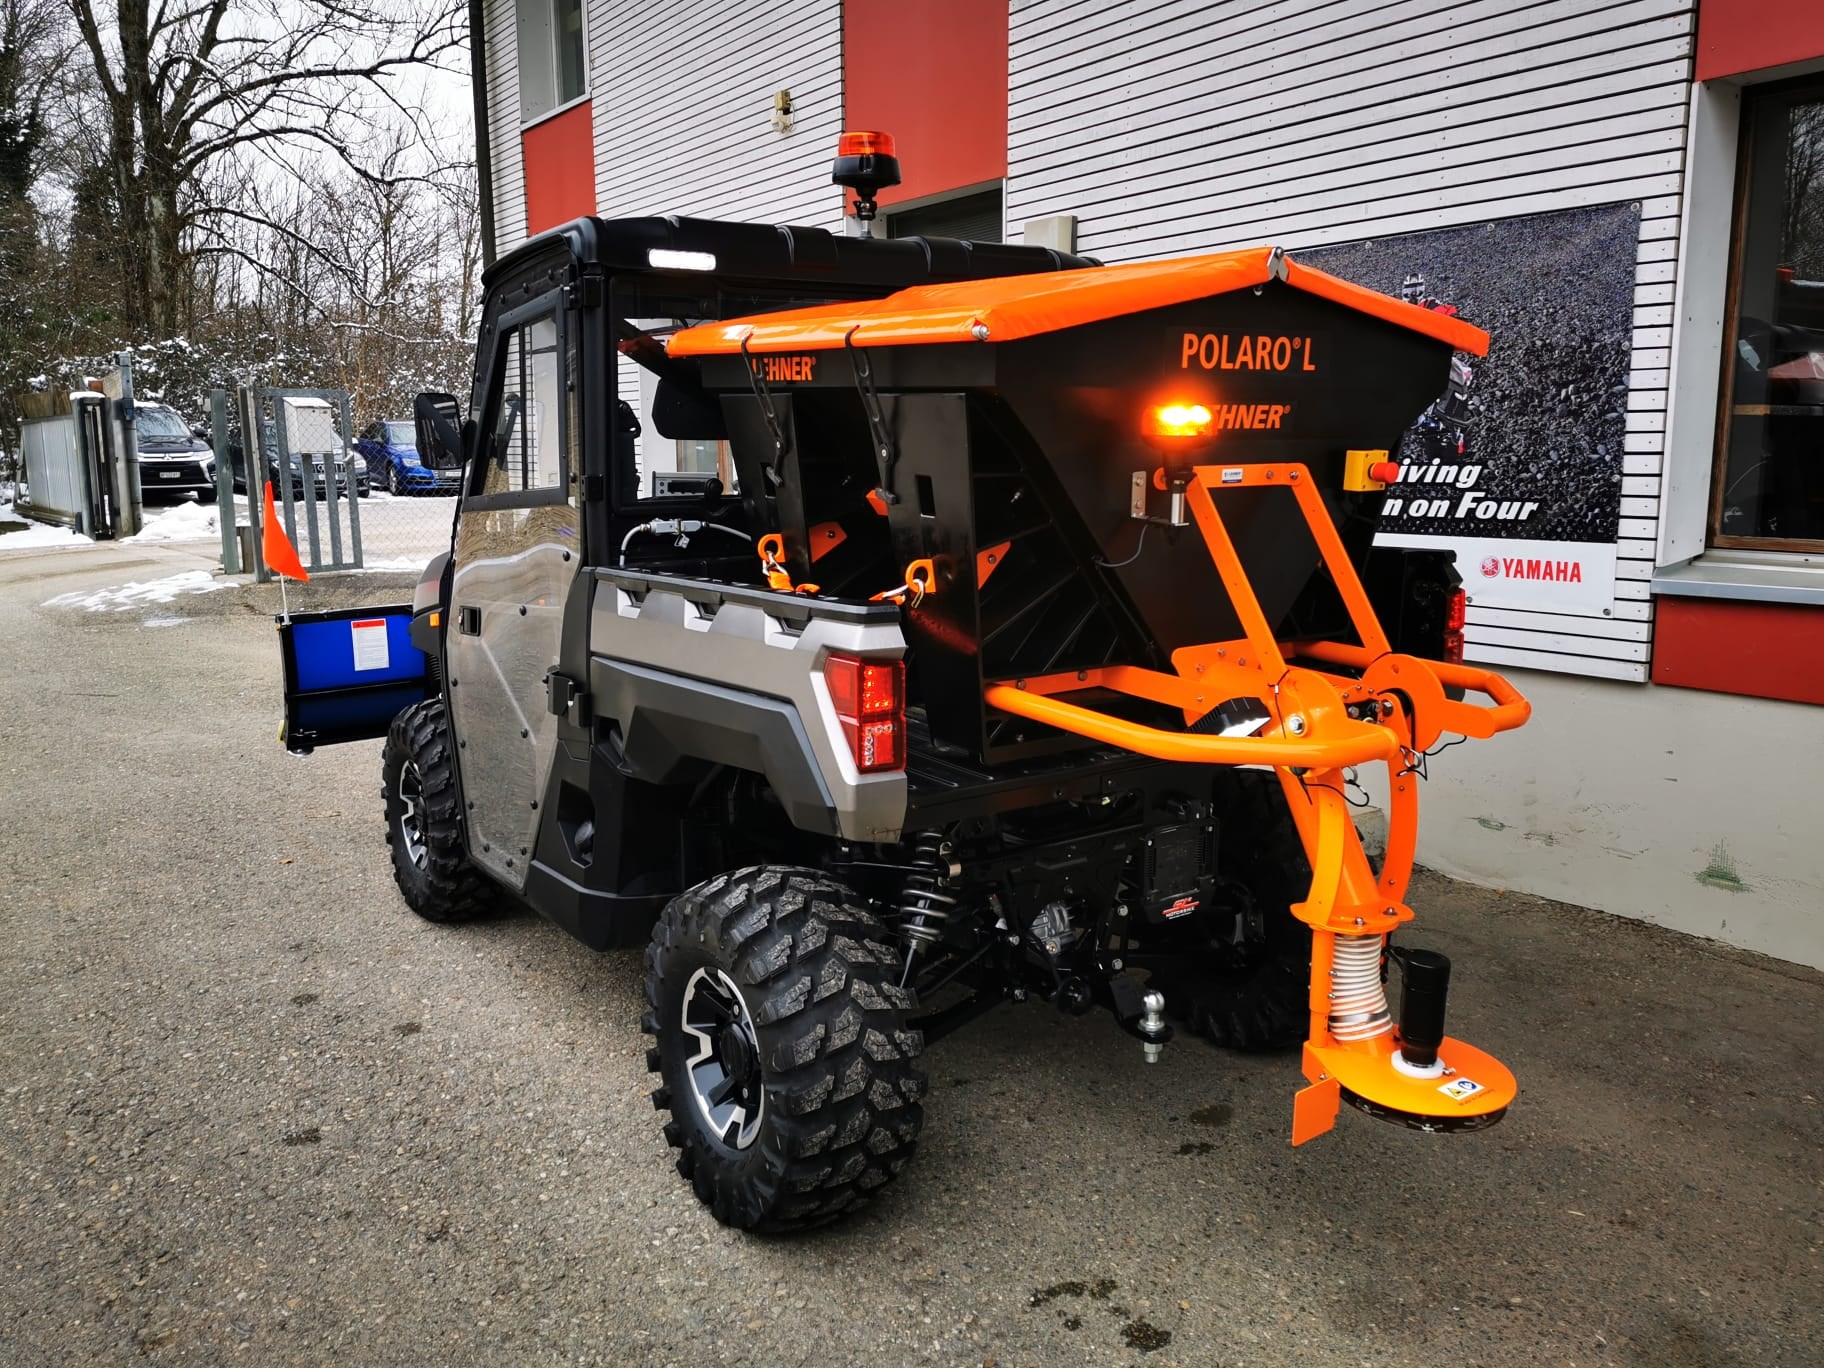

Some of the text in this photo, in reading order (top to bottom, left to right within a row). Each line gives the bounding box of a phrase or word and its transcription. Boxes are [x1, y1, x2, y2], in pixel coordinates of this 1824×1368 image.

[1303, 337, 1316, 371] L
[1213, 404, 1291, 430] HNER®
[1408, 499, 1450, 518] on
[1454, 491, 1540, 521] Four
[1502, 557, 1582, 584] YAMAHA
